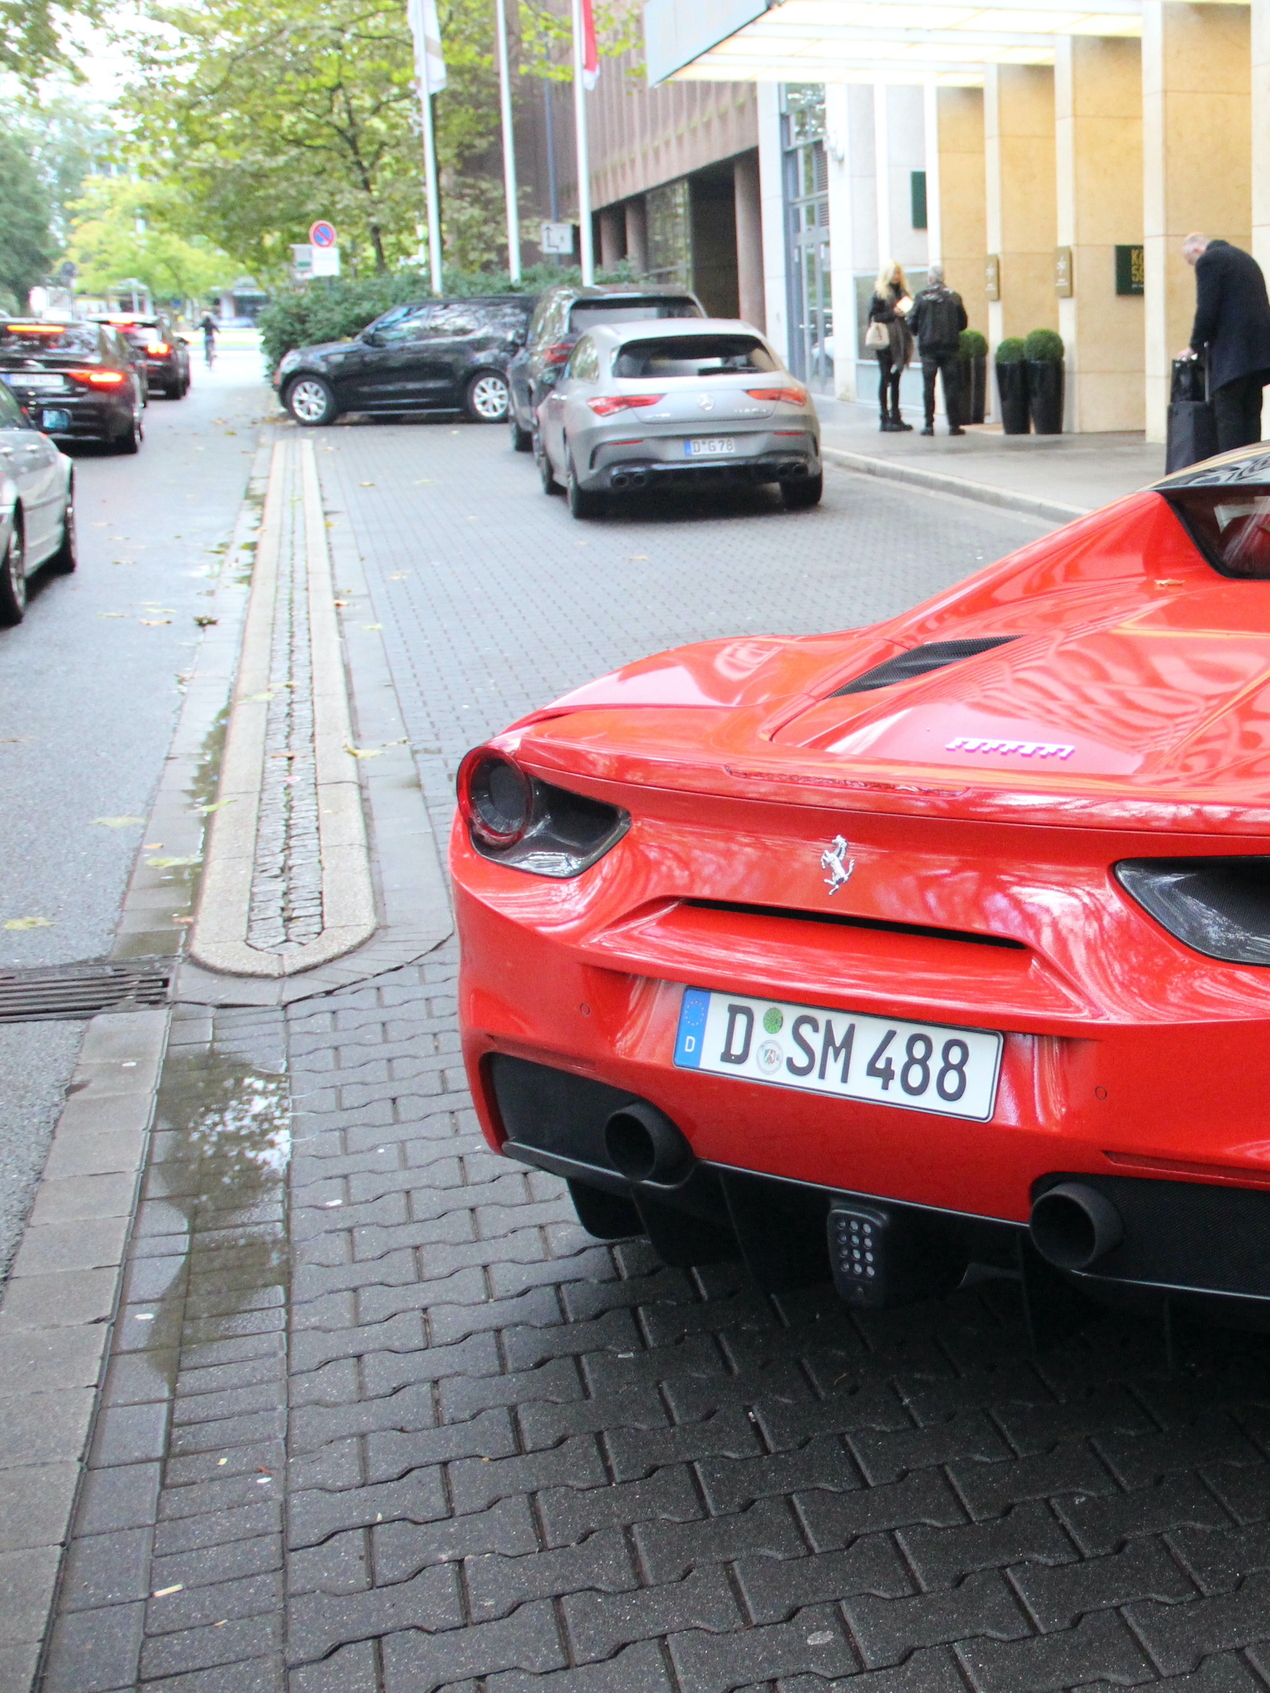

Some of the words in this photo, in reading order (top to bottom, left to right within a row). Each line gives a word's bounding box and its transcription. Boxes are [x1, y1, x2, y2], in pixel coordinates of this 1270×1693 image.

[692, 441, 701, 452] D
[684, 1035, 695, 1053] D
[720, 1003, 754, 1065] D
[786, 1014, 856, 1084] SM
[866, 1029, 969, 1102] 488
